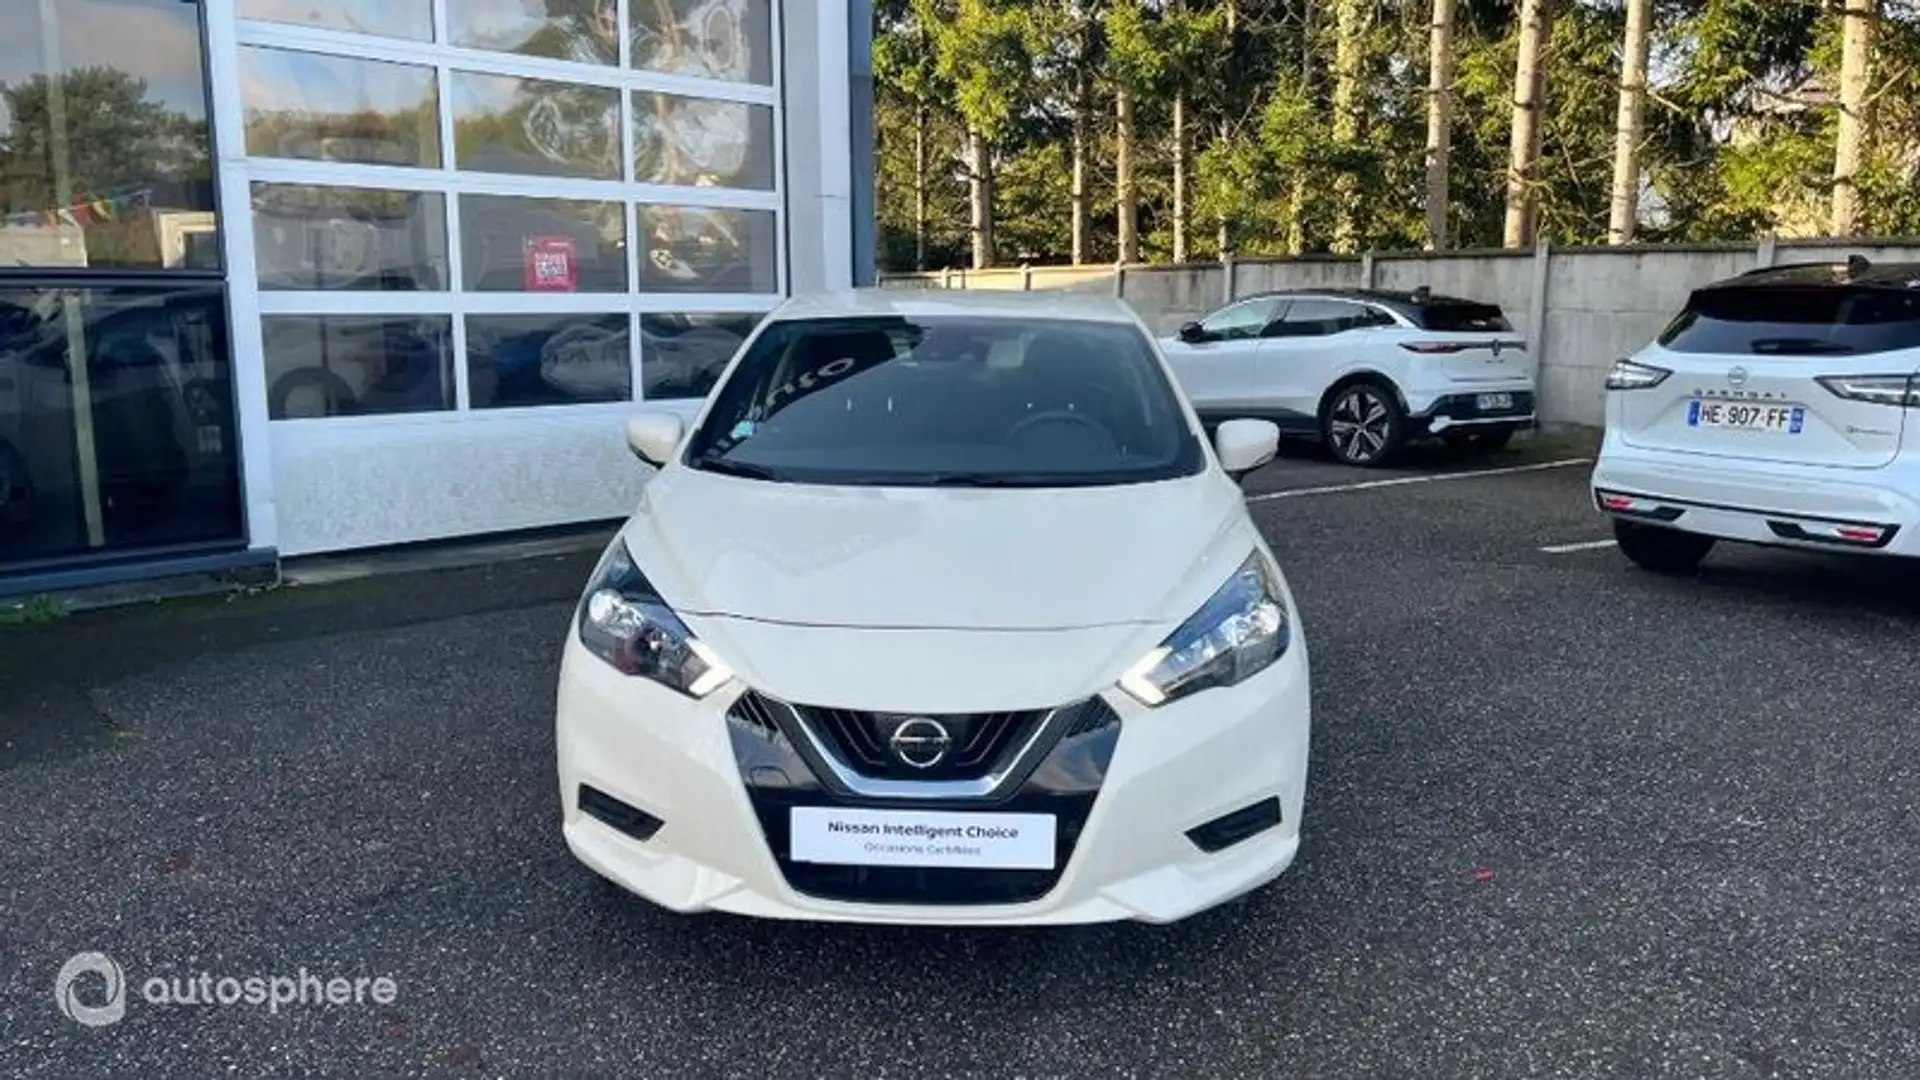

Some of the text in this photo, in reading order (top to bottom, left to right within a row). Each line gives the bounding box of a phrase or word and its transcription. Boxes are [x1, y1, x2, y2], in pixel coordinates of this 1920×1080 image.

[828, 821, 1019, 841] Nissan Intelligent Choice
